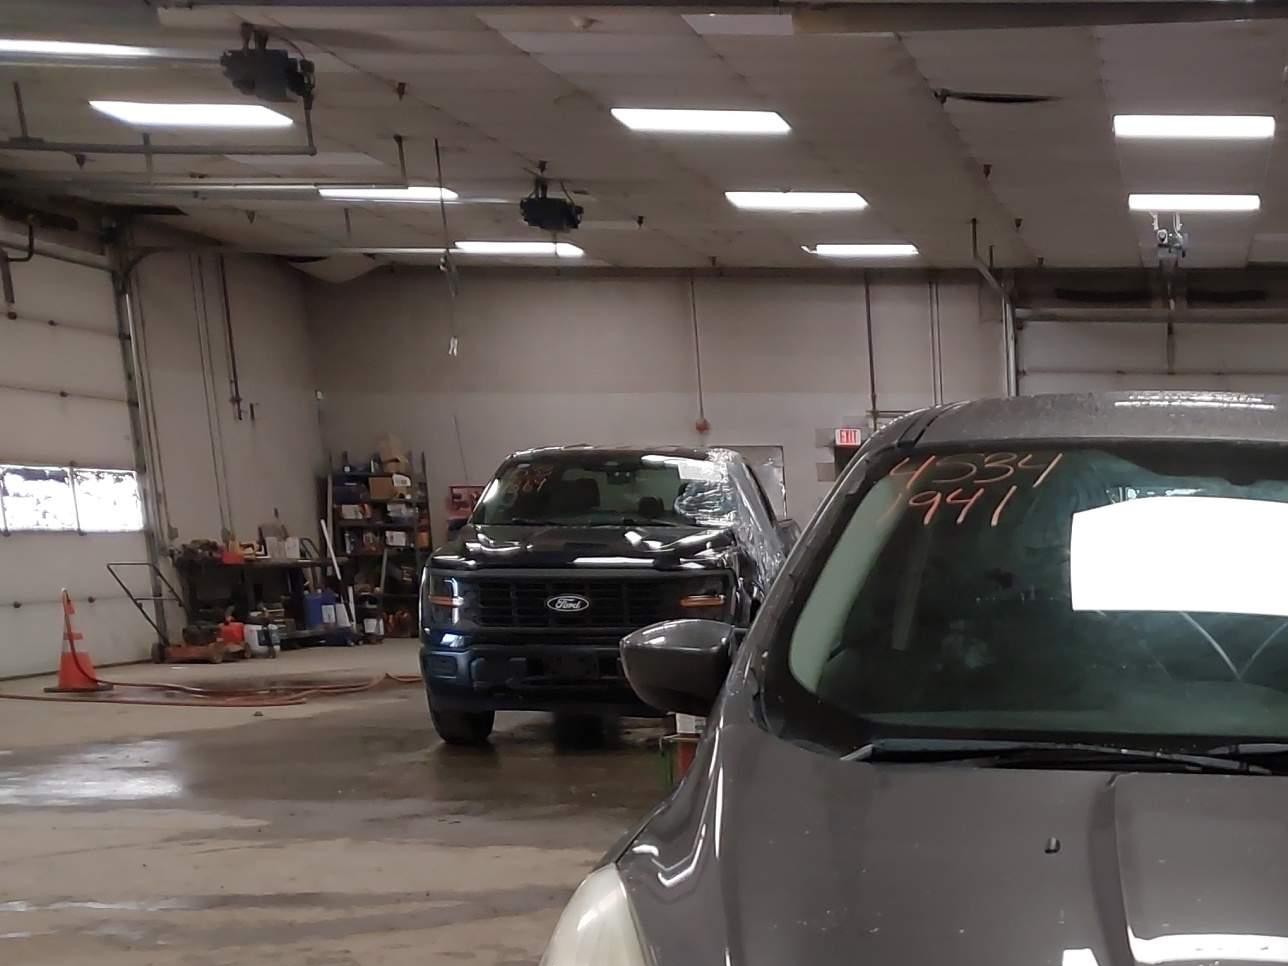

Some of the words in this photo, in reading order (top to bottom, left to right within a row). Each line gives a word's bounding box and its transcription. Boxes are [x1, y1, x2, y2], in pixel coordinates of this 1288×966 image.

[839, 429, 858, 444] EXIT
[889, 452, 1064, 490] 4534
[555, 598, 581, 609] Ford
